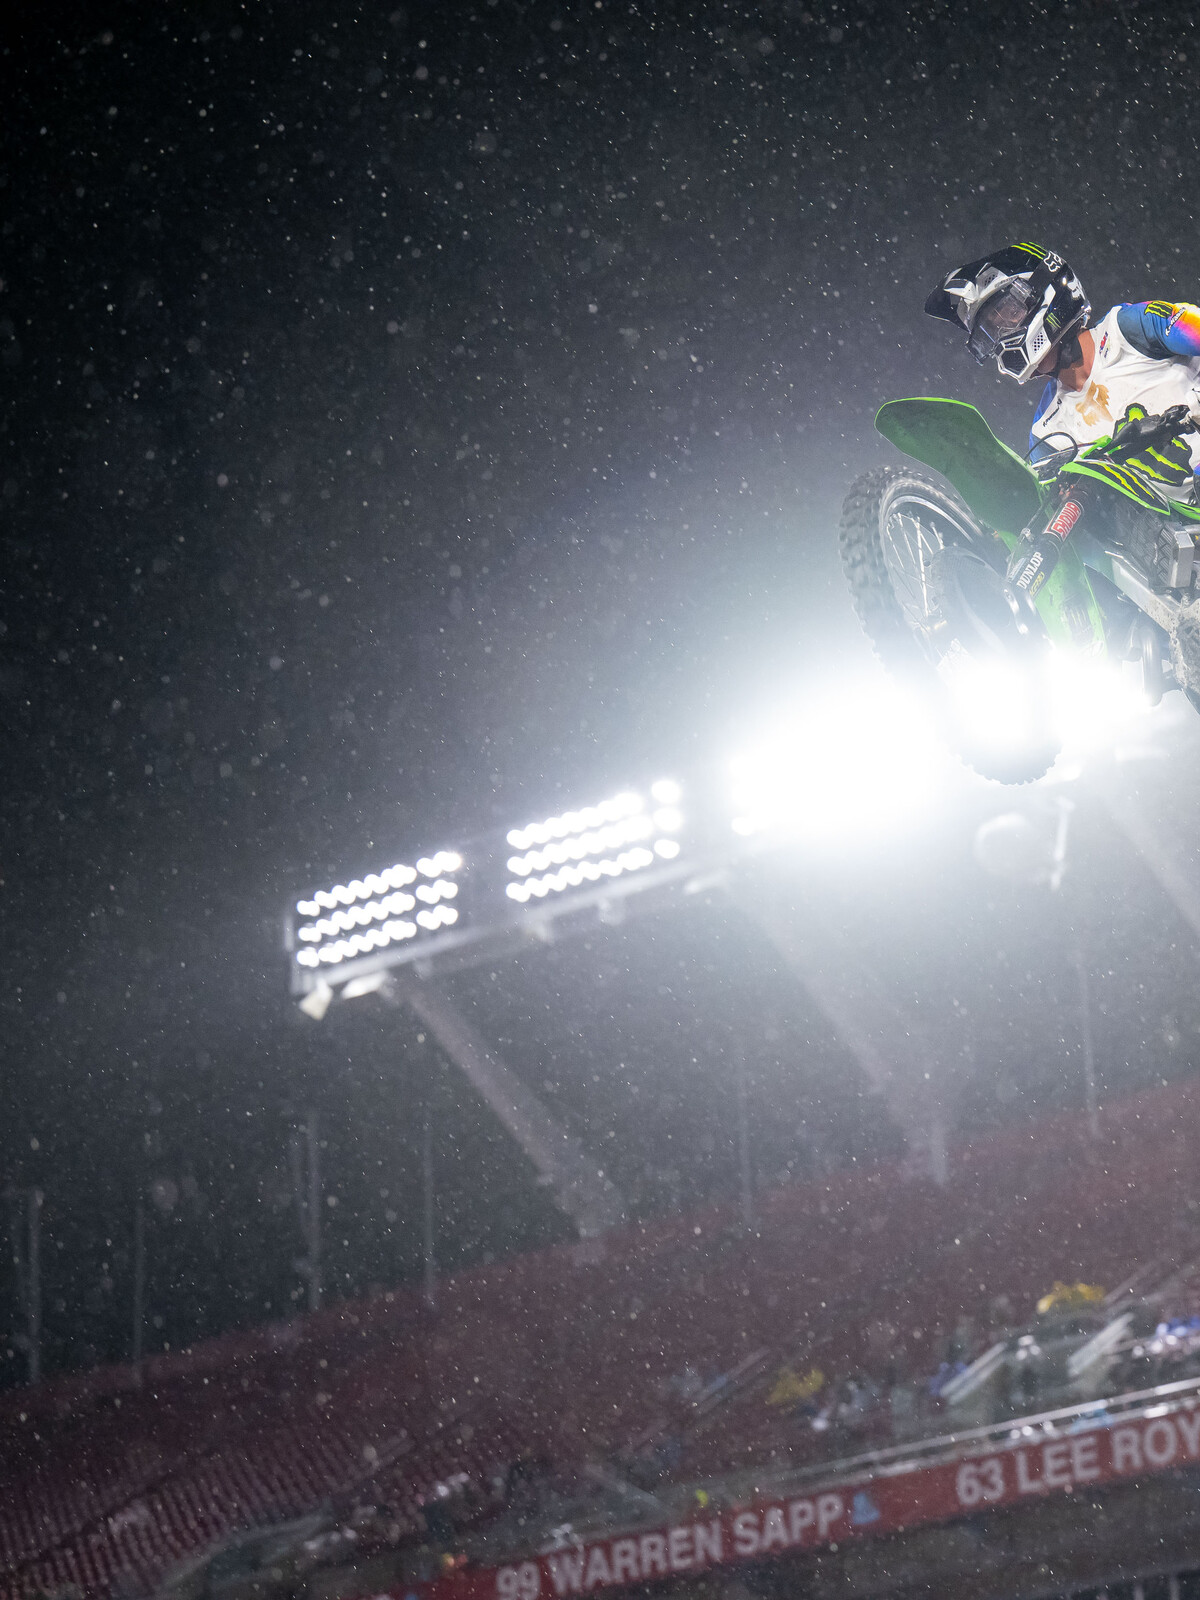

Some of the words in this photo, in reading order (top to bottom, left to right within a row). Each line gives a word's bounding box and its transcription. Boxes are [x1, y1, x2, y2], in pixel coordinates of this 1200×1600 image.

[1051, 501, 1081, 542] SHOWA
[1016, 551, 1044, 590] DUNLOP
[956, 1458, 1002, 1504] 63
[1016, 1434, 1100, 1493] LEE
[497, 1562, 541, 1600] 99
[548, 1520, 723, 1598] WARREN
[734, 1494, 843, 1554] SAPP
